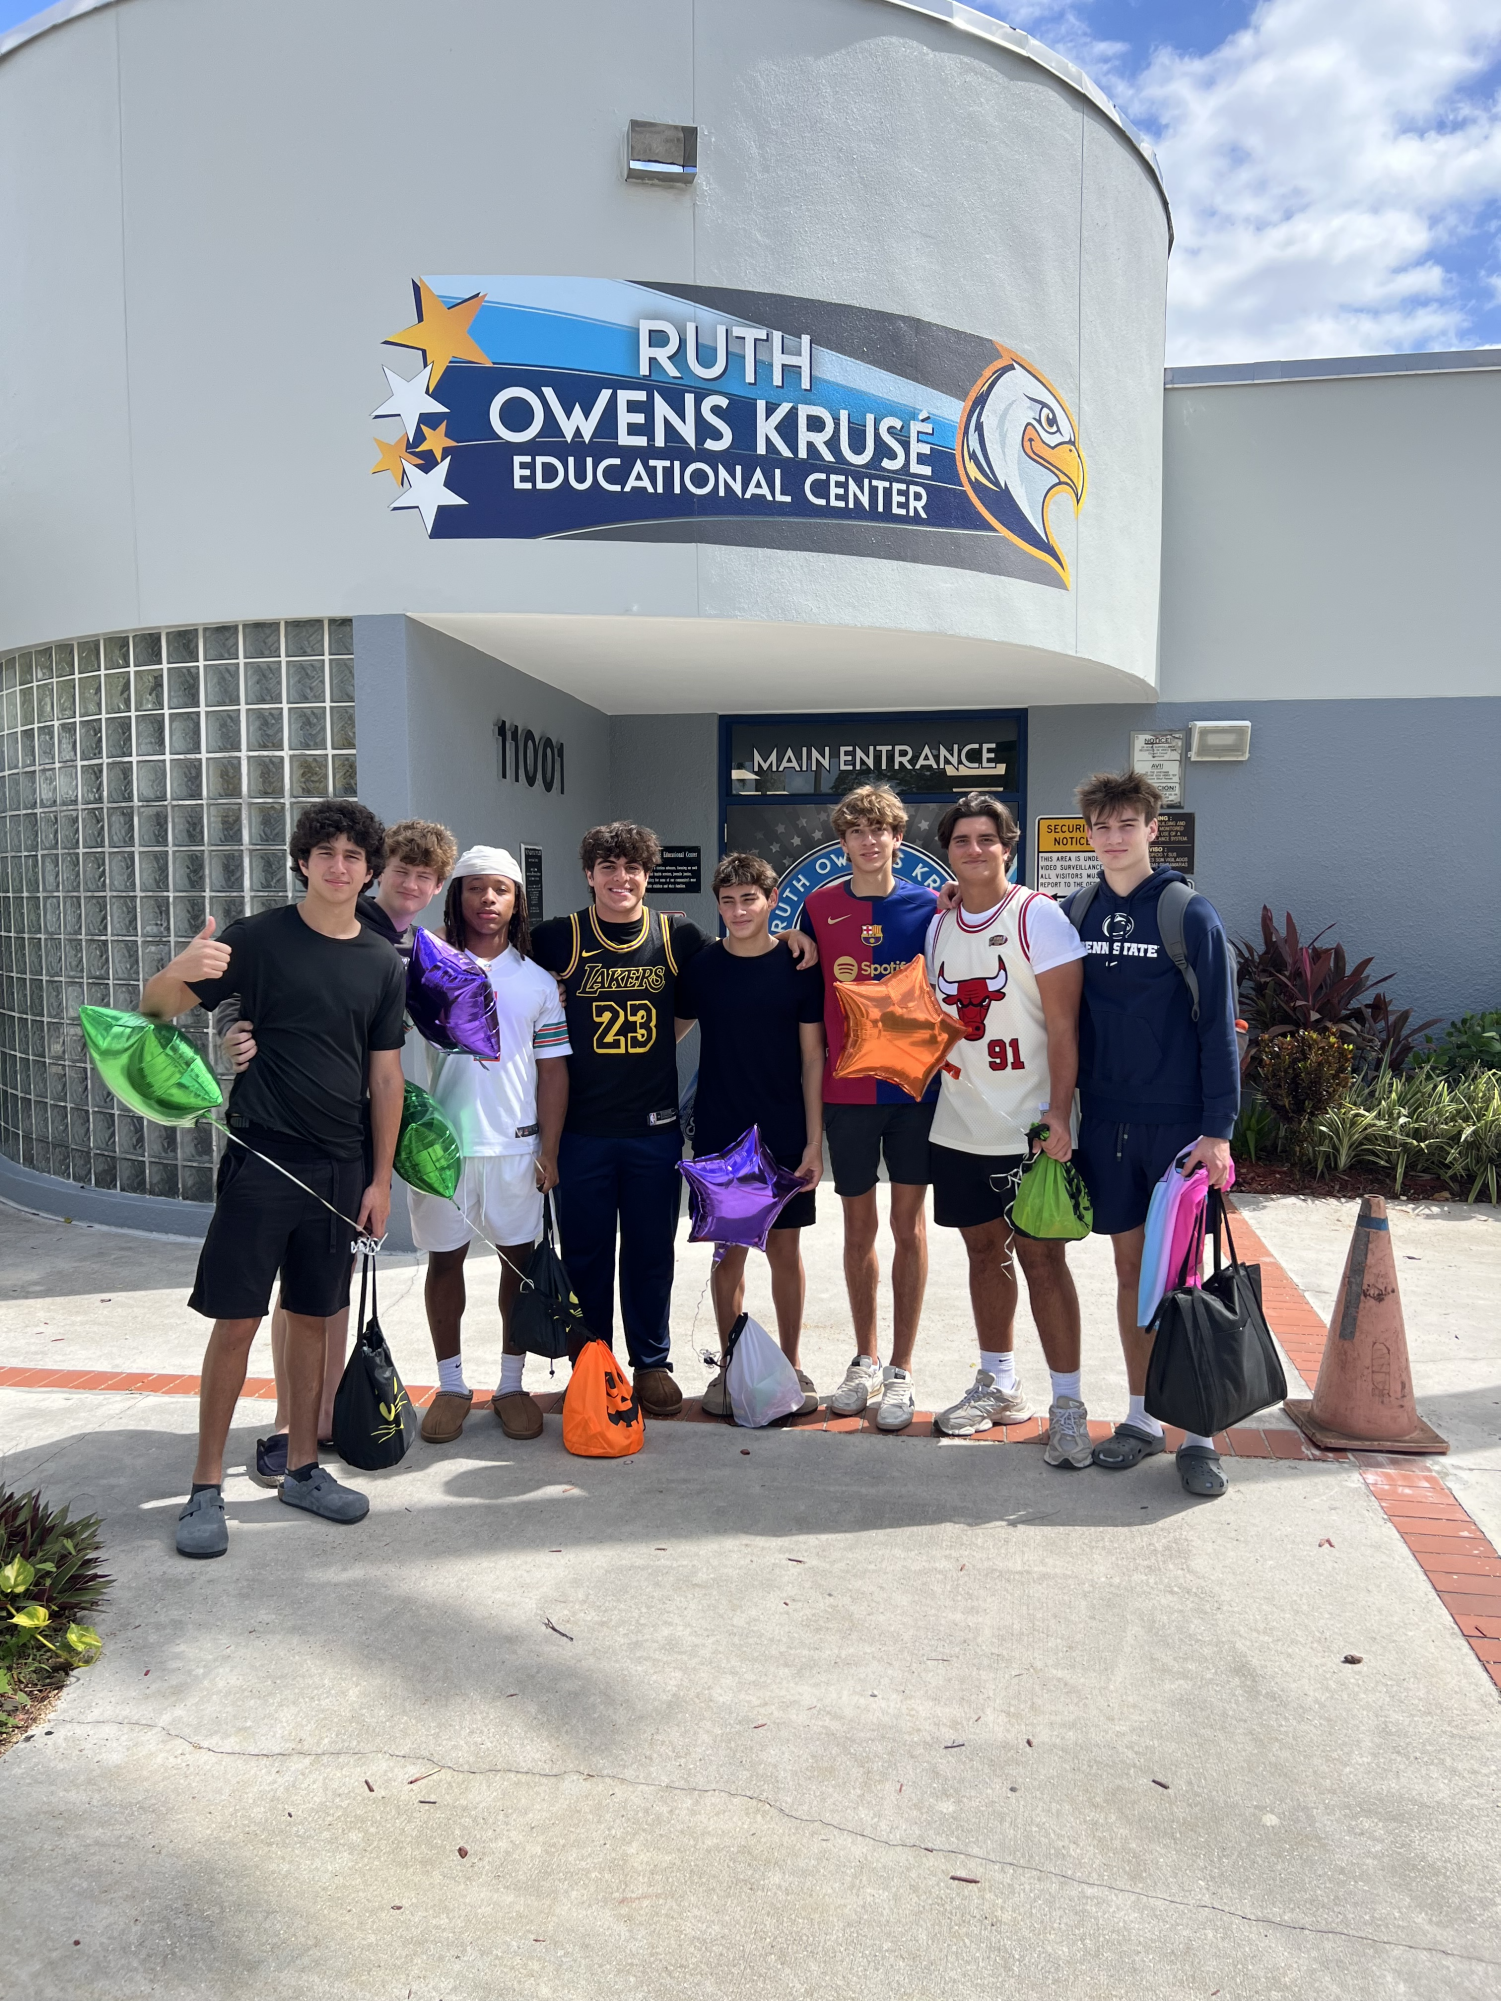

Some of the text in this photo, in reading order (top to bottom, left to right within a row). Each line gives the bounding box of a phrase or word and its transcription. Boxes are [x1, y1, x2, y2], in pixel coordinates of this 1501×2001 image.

[638, 319, 812, 390] RUTH
[488, 386, 936, 476] OWENS KRUSÉ
[512, 455, 928, 518] EDUCATIONAL CENTER
[497, 719, 565, 795] 11001
[753, 743, 997, 772] MAIN ENTRANCE
[1046, 824, 1086, 834] SECURI
[1056, 872, 1083, 880] VISITORS
[1087, 872, 1099, 880] MUS
[770, 874, 811, 933] RUTH
[1080, 941, 1158, 958] ENN STATE
[576, 963, 666, 997] LAKERS
[592, 1000, 657, 1054] 23
[987, 1037, 1026, 1071] 91
